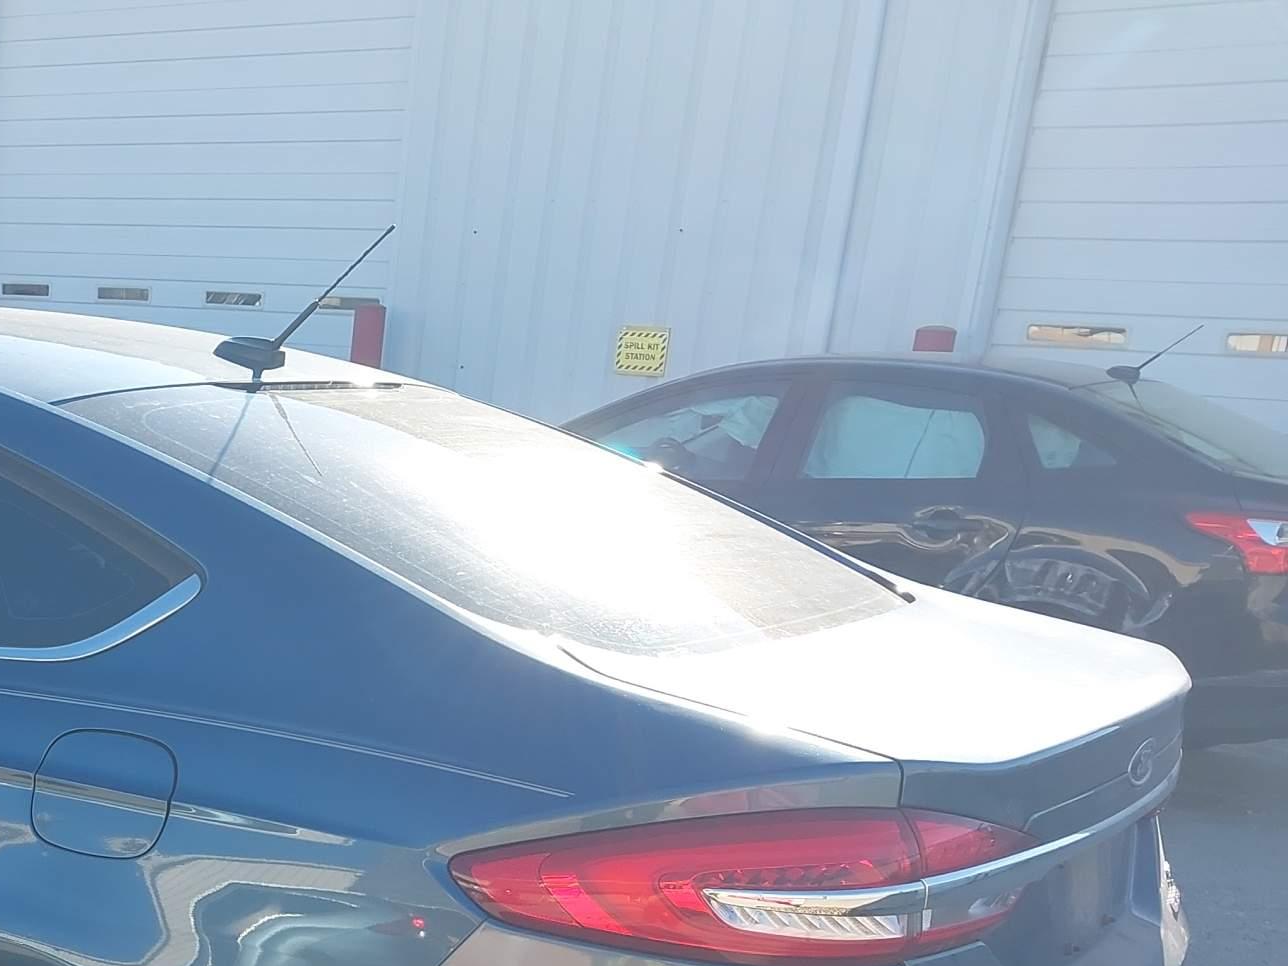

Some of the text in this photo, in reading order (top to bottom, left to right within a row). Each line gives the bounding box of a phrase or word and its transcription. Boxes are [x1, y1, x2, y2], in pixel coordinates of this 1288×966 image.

[624, 341, 660, 351] SPILL KIT
[624, 352, 656, 361] STATION
